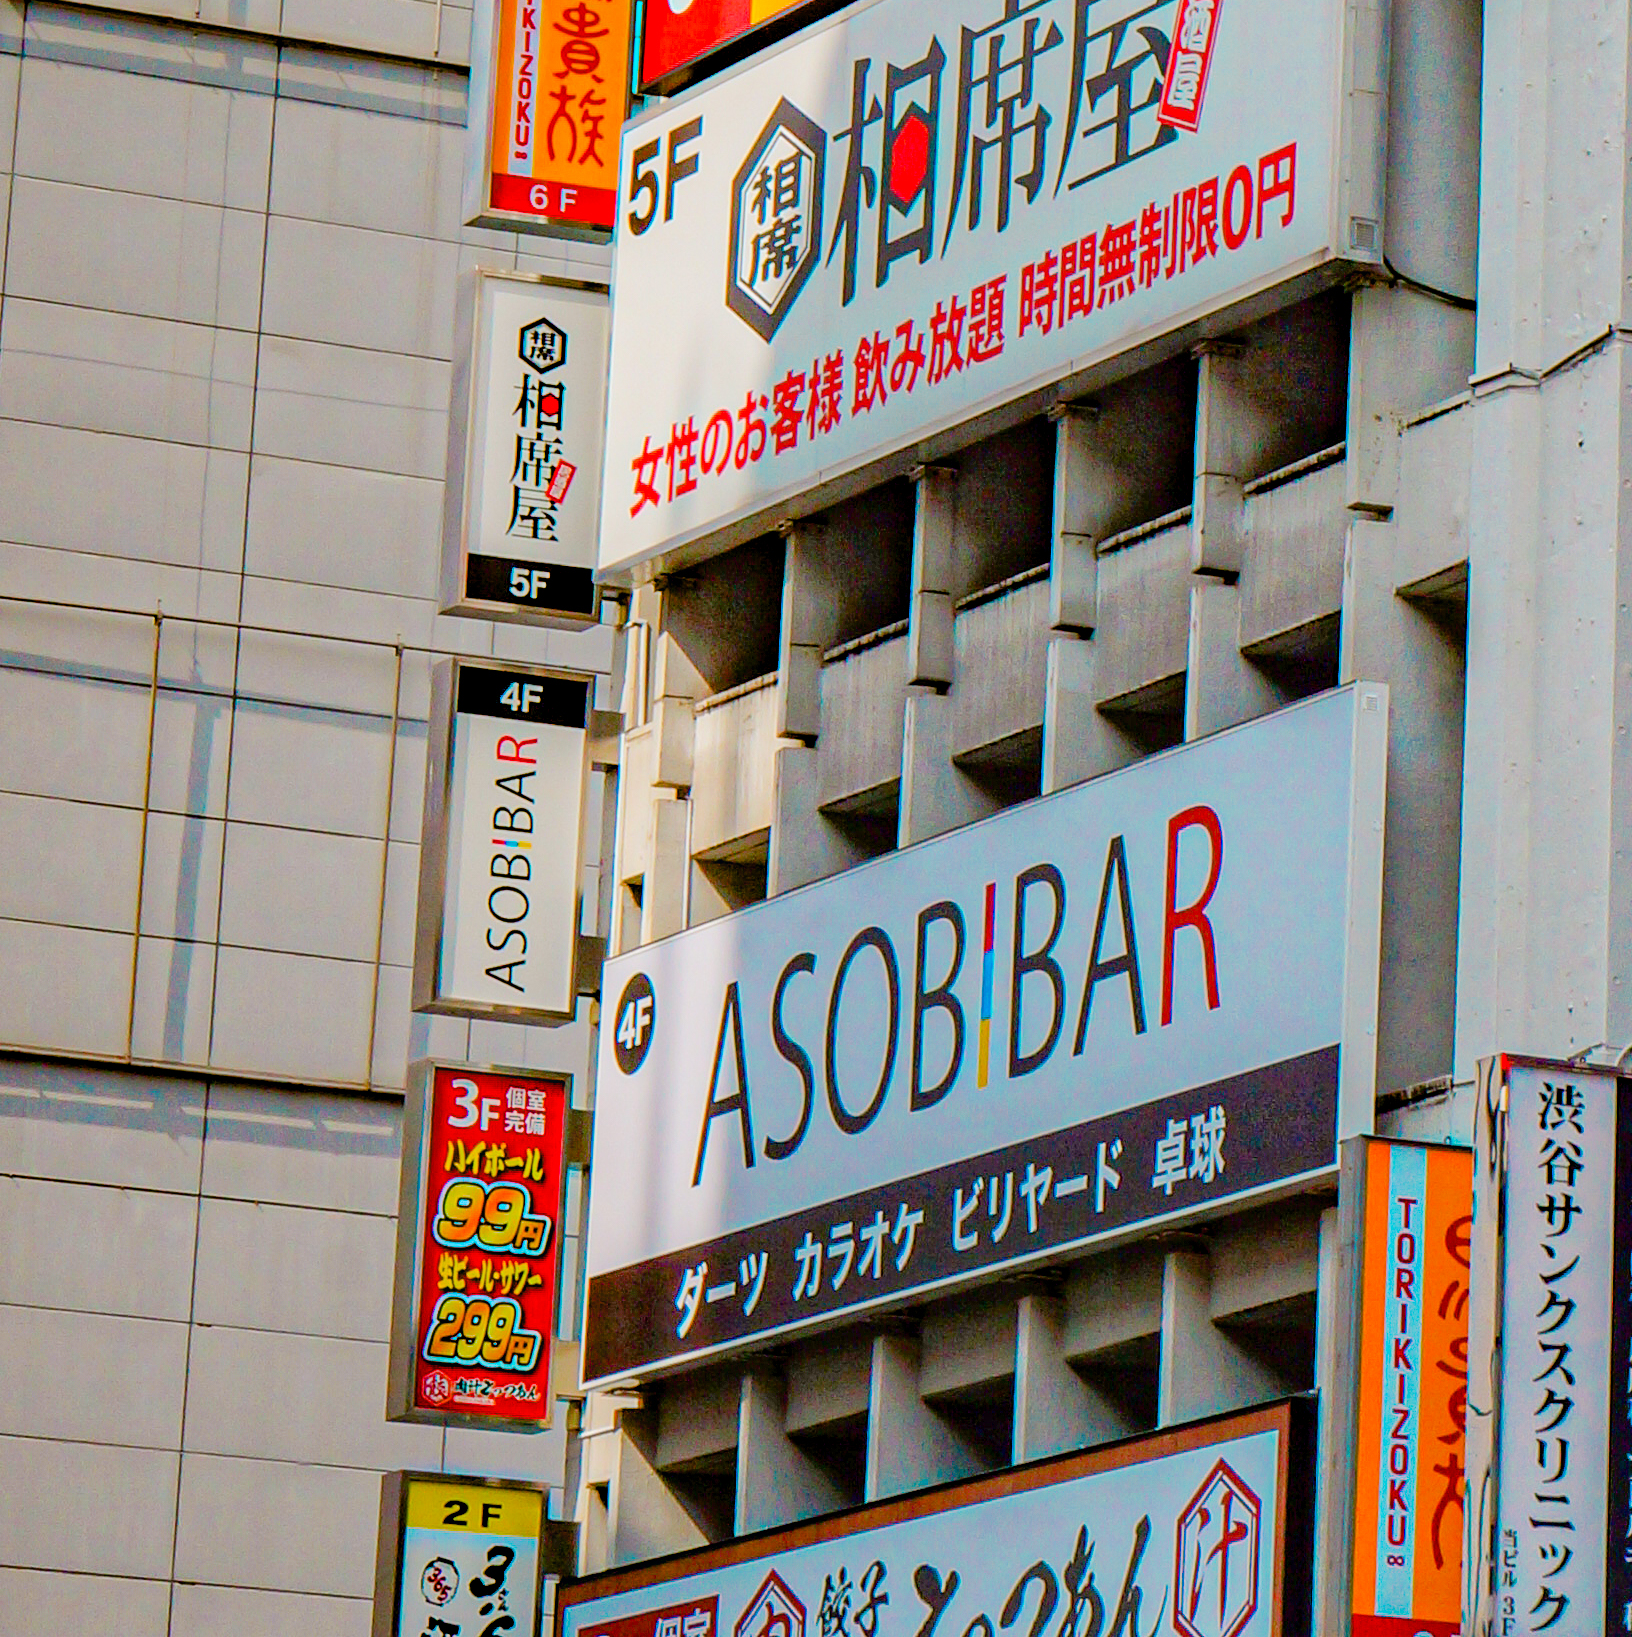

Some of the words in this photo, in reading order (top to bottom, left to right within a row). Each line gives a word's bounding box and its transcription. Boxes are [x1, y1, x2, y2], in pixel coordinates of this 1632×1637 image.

[528, 183, 578, 213] 6F
[626, 116, 703, 236] 5F
[749, 152, 803, 285] 相席
[629, 347, 845, 519] 女性のお客様
[851, 272, 1007, 419] 飲み放題
[505, 372, 567, 543] 相席屋
[508, 572, 551, 599] 5F
[500, 682, 543, 713] 4F
[483, 733, 539, 993] ASOBIBAR
[616, 1000, 651, 1051] 4F
[690, 804, 1226, 1189] ASOBIBAR
[448, 1078, 501, 1132] 3F
[503, 1110, 546, 1136] 完備
[505, 1086, 547, 1112] 個室
[444, 1138, 544, 1181] ハイボール
[436, 1181, 547, 1251] 99円
[674, 1249, 771, 1339] ダーツ
[793, 1202, 924, 1302] カラオケ
[951, 1139, 1123, 1255] ビリヤード
[1152, 1104, 1227, 1197] 卓球
[437, 1251, 542, 1296] 生ビール・サワー
[429, 1297, 535, 1365] 299円
[1529, 1081, 1585, 1632] 渋谷サンクスクリニック
[1385, 1197, 1419, 1547] TORIKIZOKU
[441, 1499, 503, 1528] 2F
[426, 1566, 453, 1602] 365
